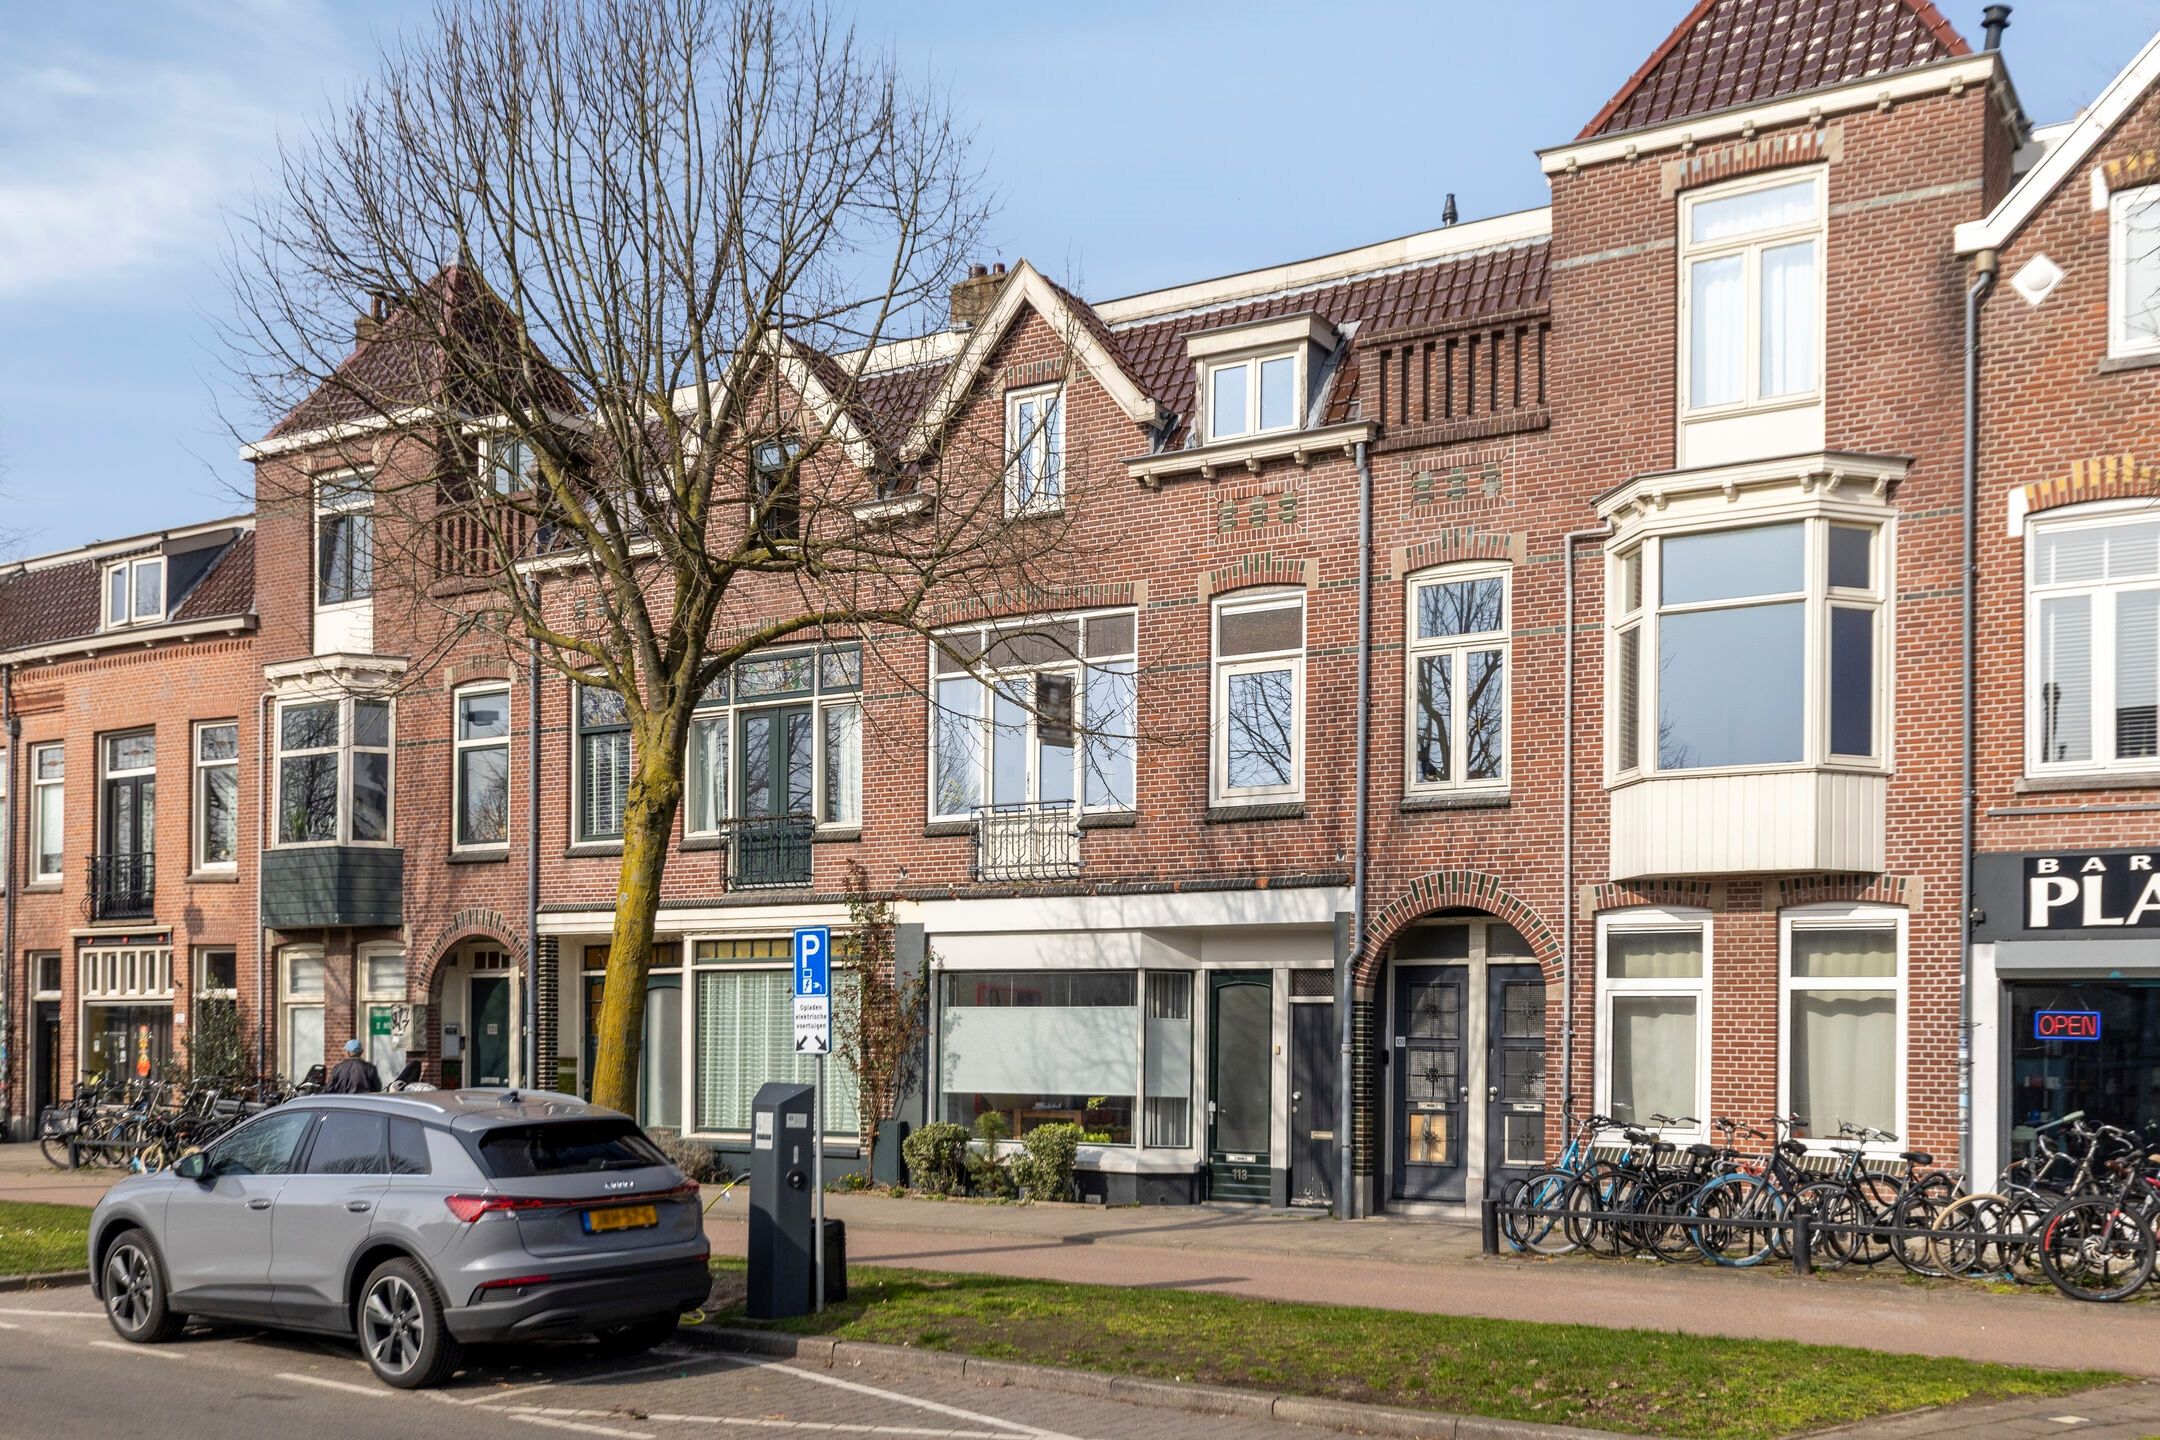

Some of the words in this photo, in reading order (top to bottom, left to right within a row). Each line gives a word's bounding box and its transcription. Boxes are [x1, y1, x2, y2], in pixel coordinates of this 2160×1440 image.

[2037, 854, 2153, 874] BAR
[802, 934, 820, 968] P
[2039, 1015, 2097, 1036] OPEN
